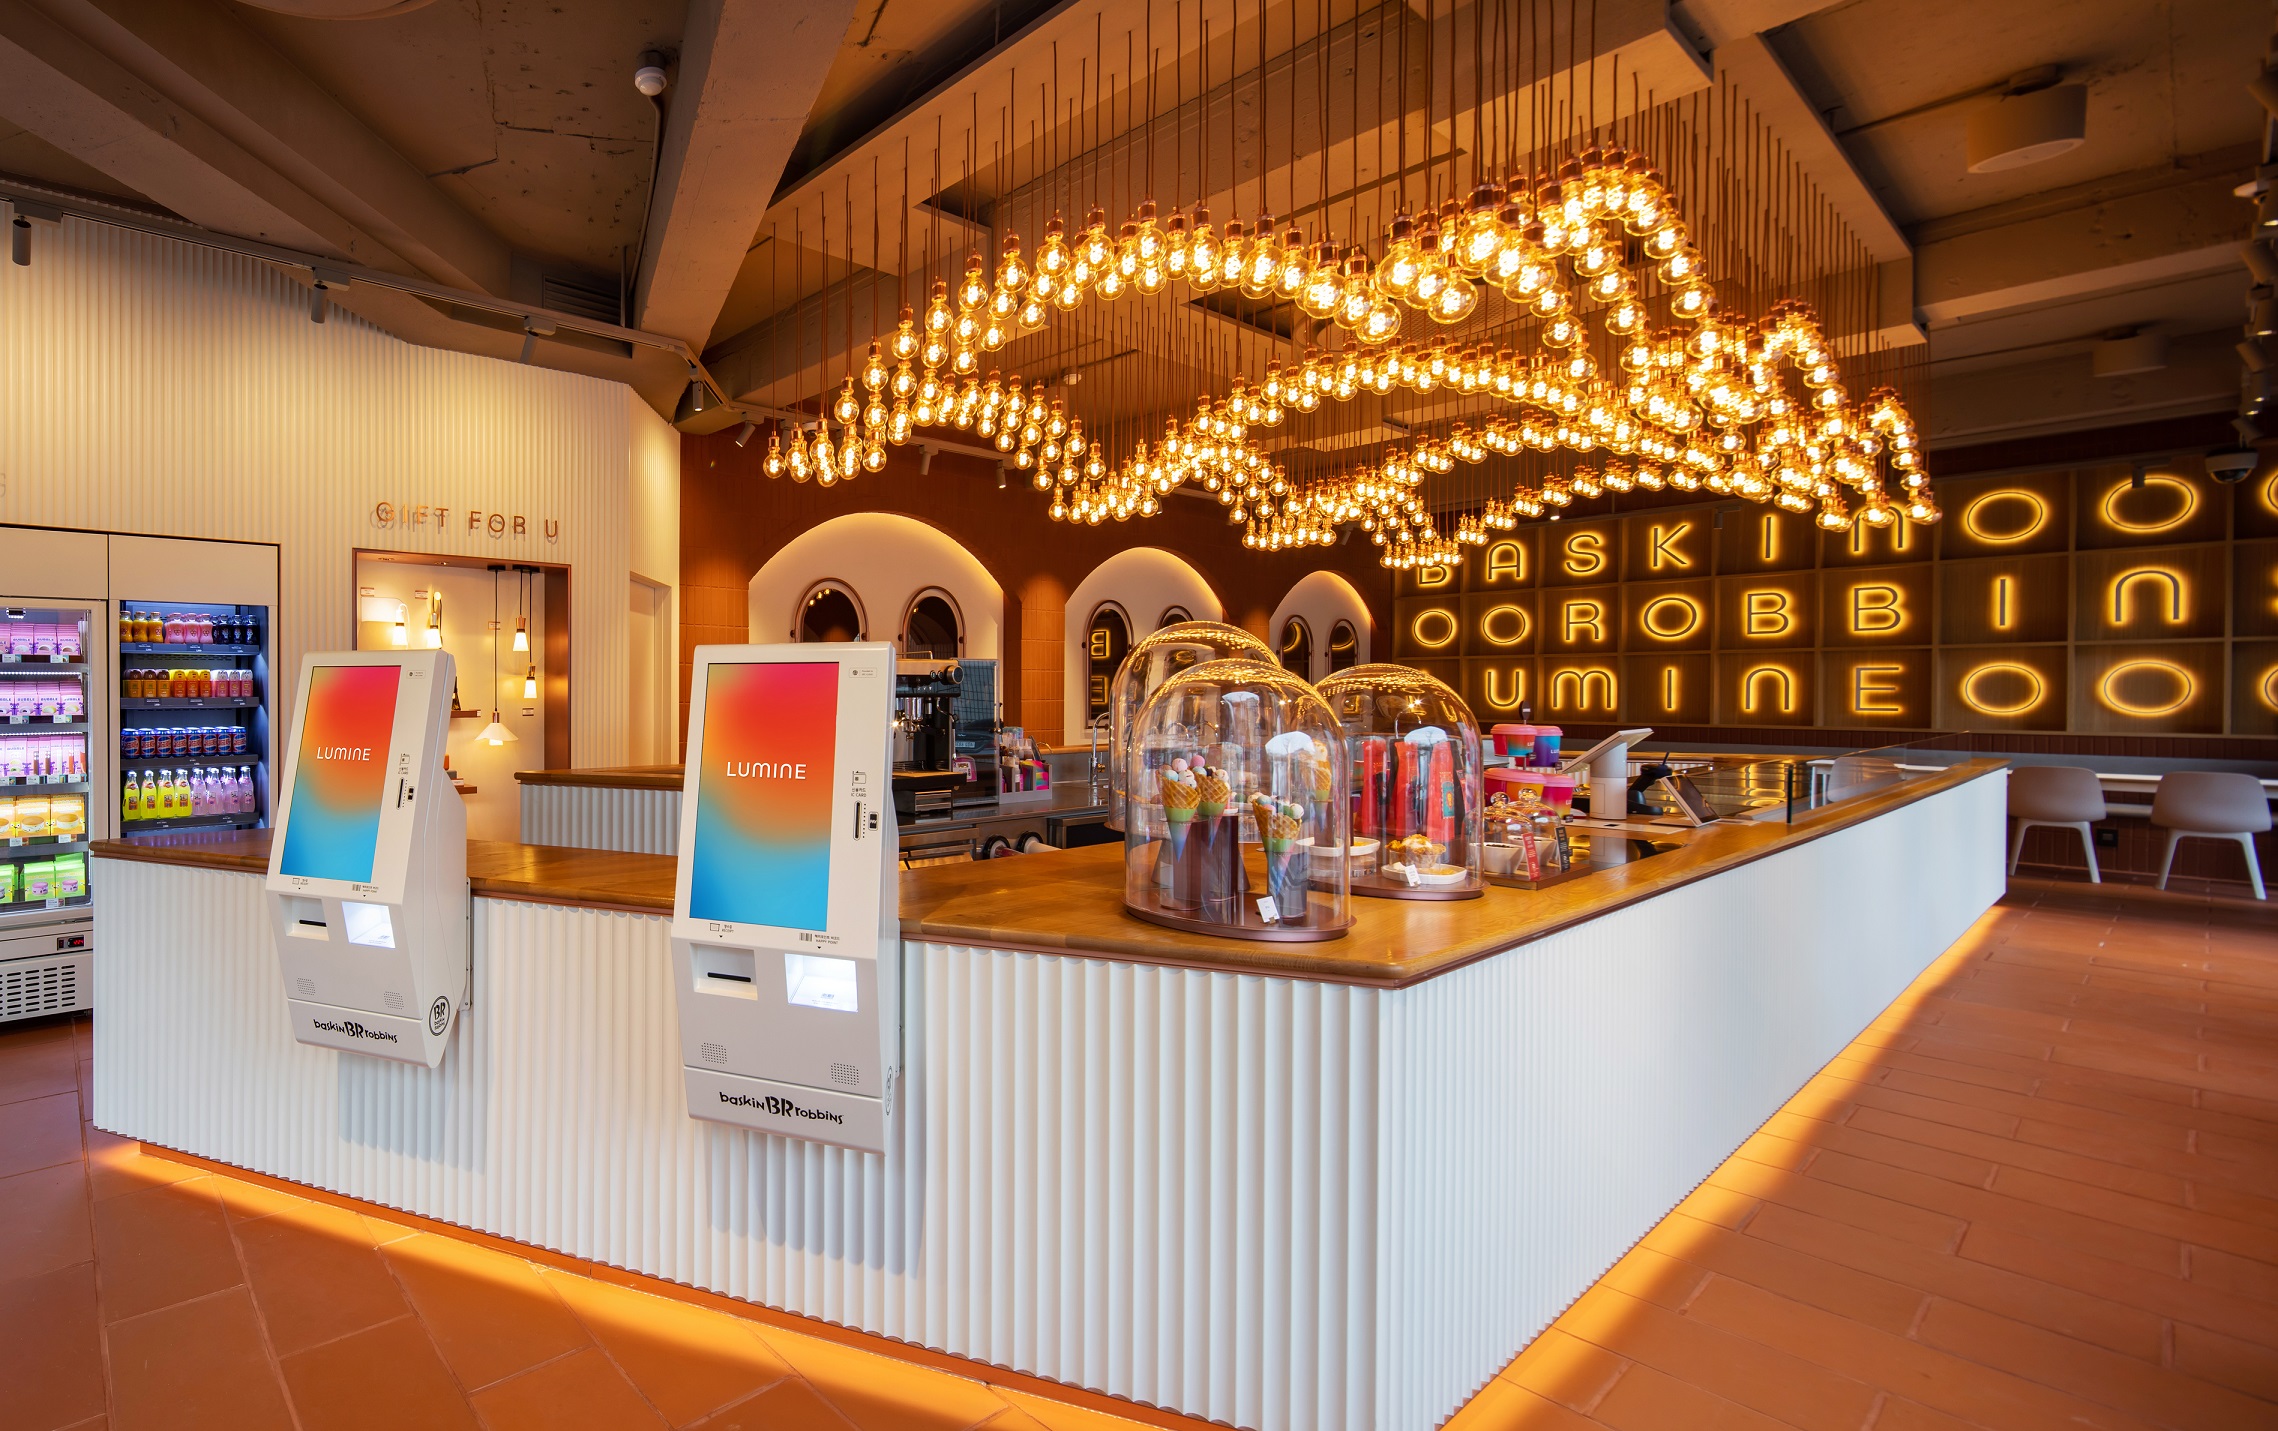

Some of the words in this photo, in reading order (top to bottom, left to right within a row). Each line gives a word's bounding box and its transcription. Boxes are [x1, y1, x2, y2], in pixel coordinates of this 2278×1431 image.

[376, 502, 449, 528] GIFT
[470, 510, 526, 535] FOR
[545, 519, 558, 538] U
[316, 746, 372, 761] LUMINE
[726, 761, 807, 780] LUMINE
[434, 1002, 446, 1020] BR
[313, 1019, 346, 1034] baskin
[343, 1021, 364, 1038] BR
[365, 1029, 398, 1043] robbins
[719, 1091, 765, 1111] baskin
[765, 1096, 794, 1117] BR
[795, 1106, 844, 1125] robbins
